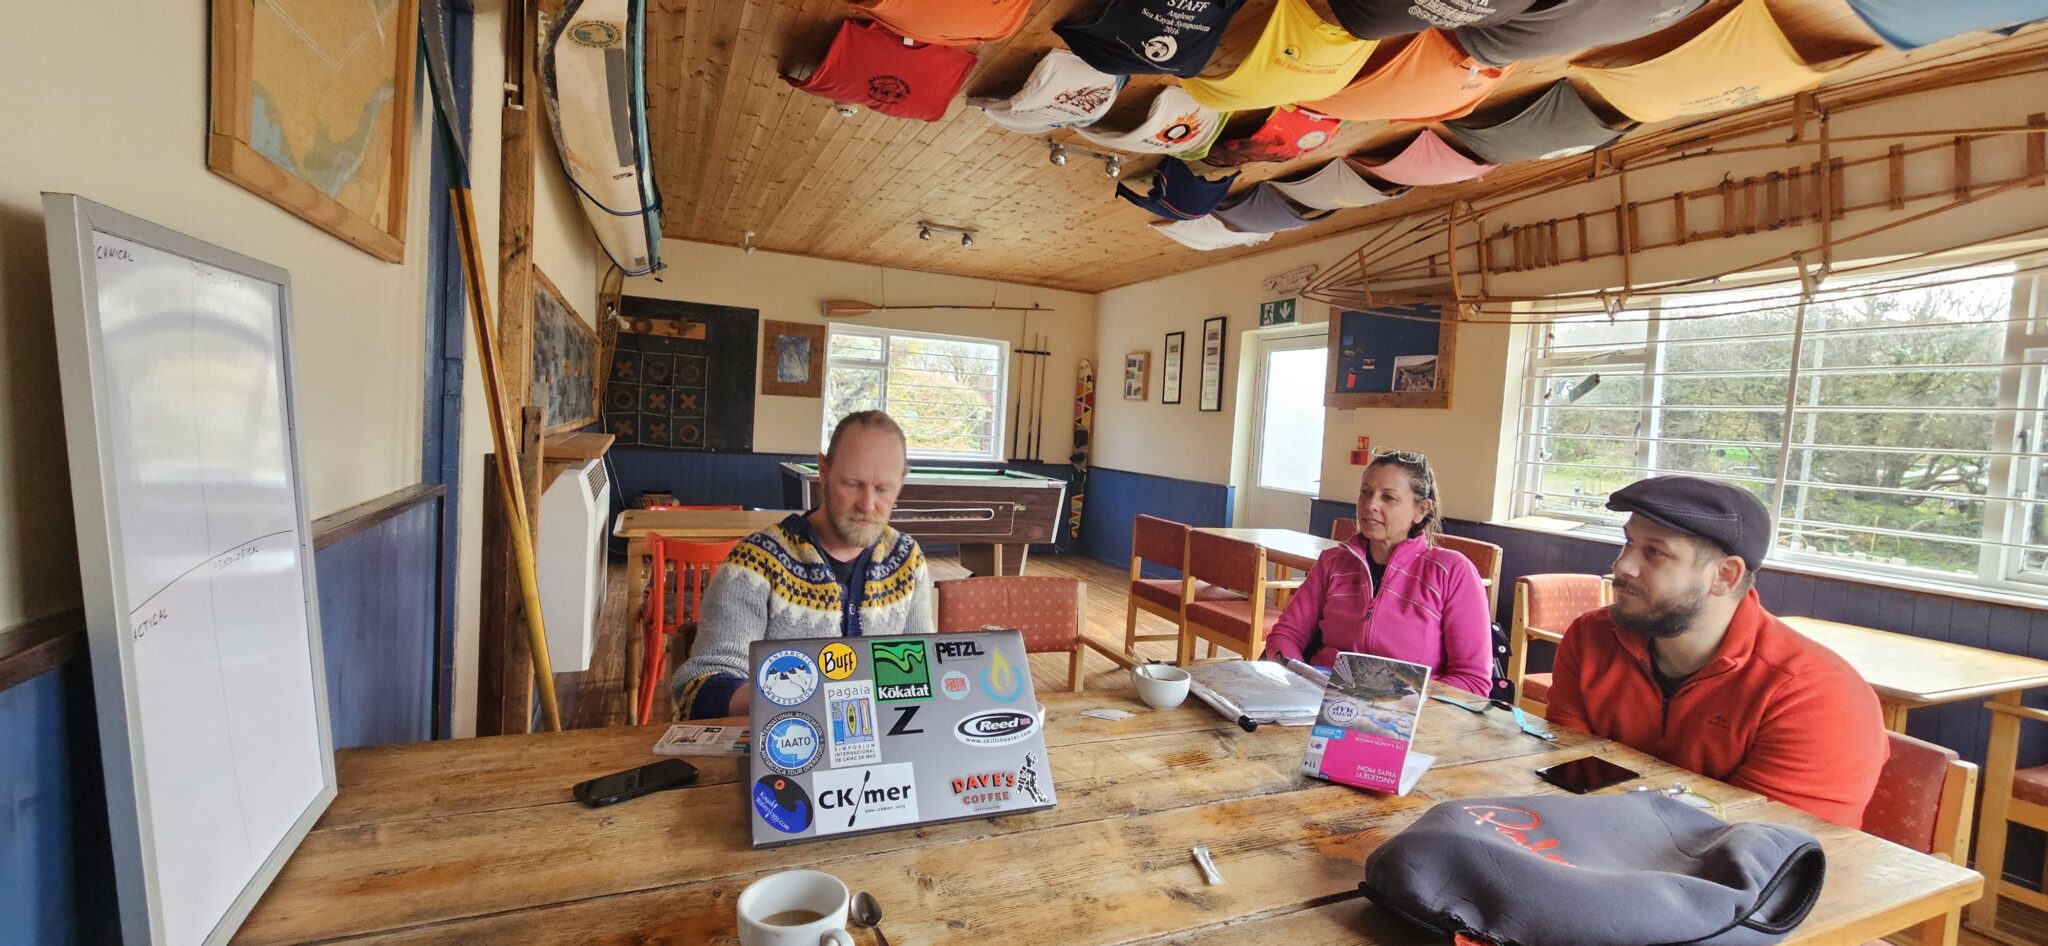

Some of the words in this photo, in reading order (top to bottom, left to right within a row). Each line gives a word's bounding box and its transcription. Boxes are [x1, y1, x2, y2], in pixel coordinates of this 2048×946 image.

[1167, 0, 1210, 12] STAFF
[1141, 8, 1154, 19] Sea
[1154, 15, 1174, 26] Kayak
[1174, 20, 1211, 32] Symposium
[1166, 9, 1196, 21] Anglesey
[1163, 26, 1180, 35] 2016
[93, 245, 134, 262] CHNICAL
[768, 651, 814, 666] ANTARCTIC
[935, 641, 985, 664] PETZL
[762, 684, 814, 704] AMBASSADOR
[828, 685, 871, 700] pagaia
[761, 712, 794, 741] INTERNATIONAL
[795, 712, 823, 737] ASSOCIATION
[980, 717, 1019, 732] Reed
[781, 736, 811, 748] IAATO
[965, 730, 1032, 744] www.chillcheater.com
[760, 750, 787, 775] ANTARCTICA
[787, 768, 804, 776] TOUR
[804, 743, 825, 772] OPERATORS
[1304, 760, 1317, 769] 114
[962, 791, 1010, 805] COFFEE
